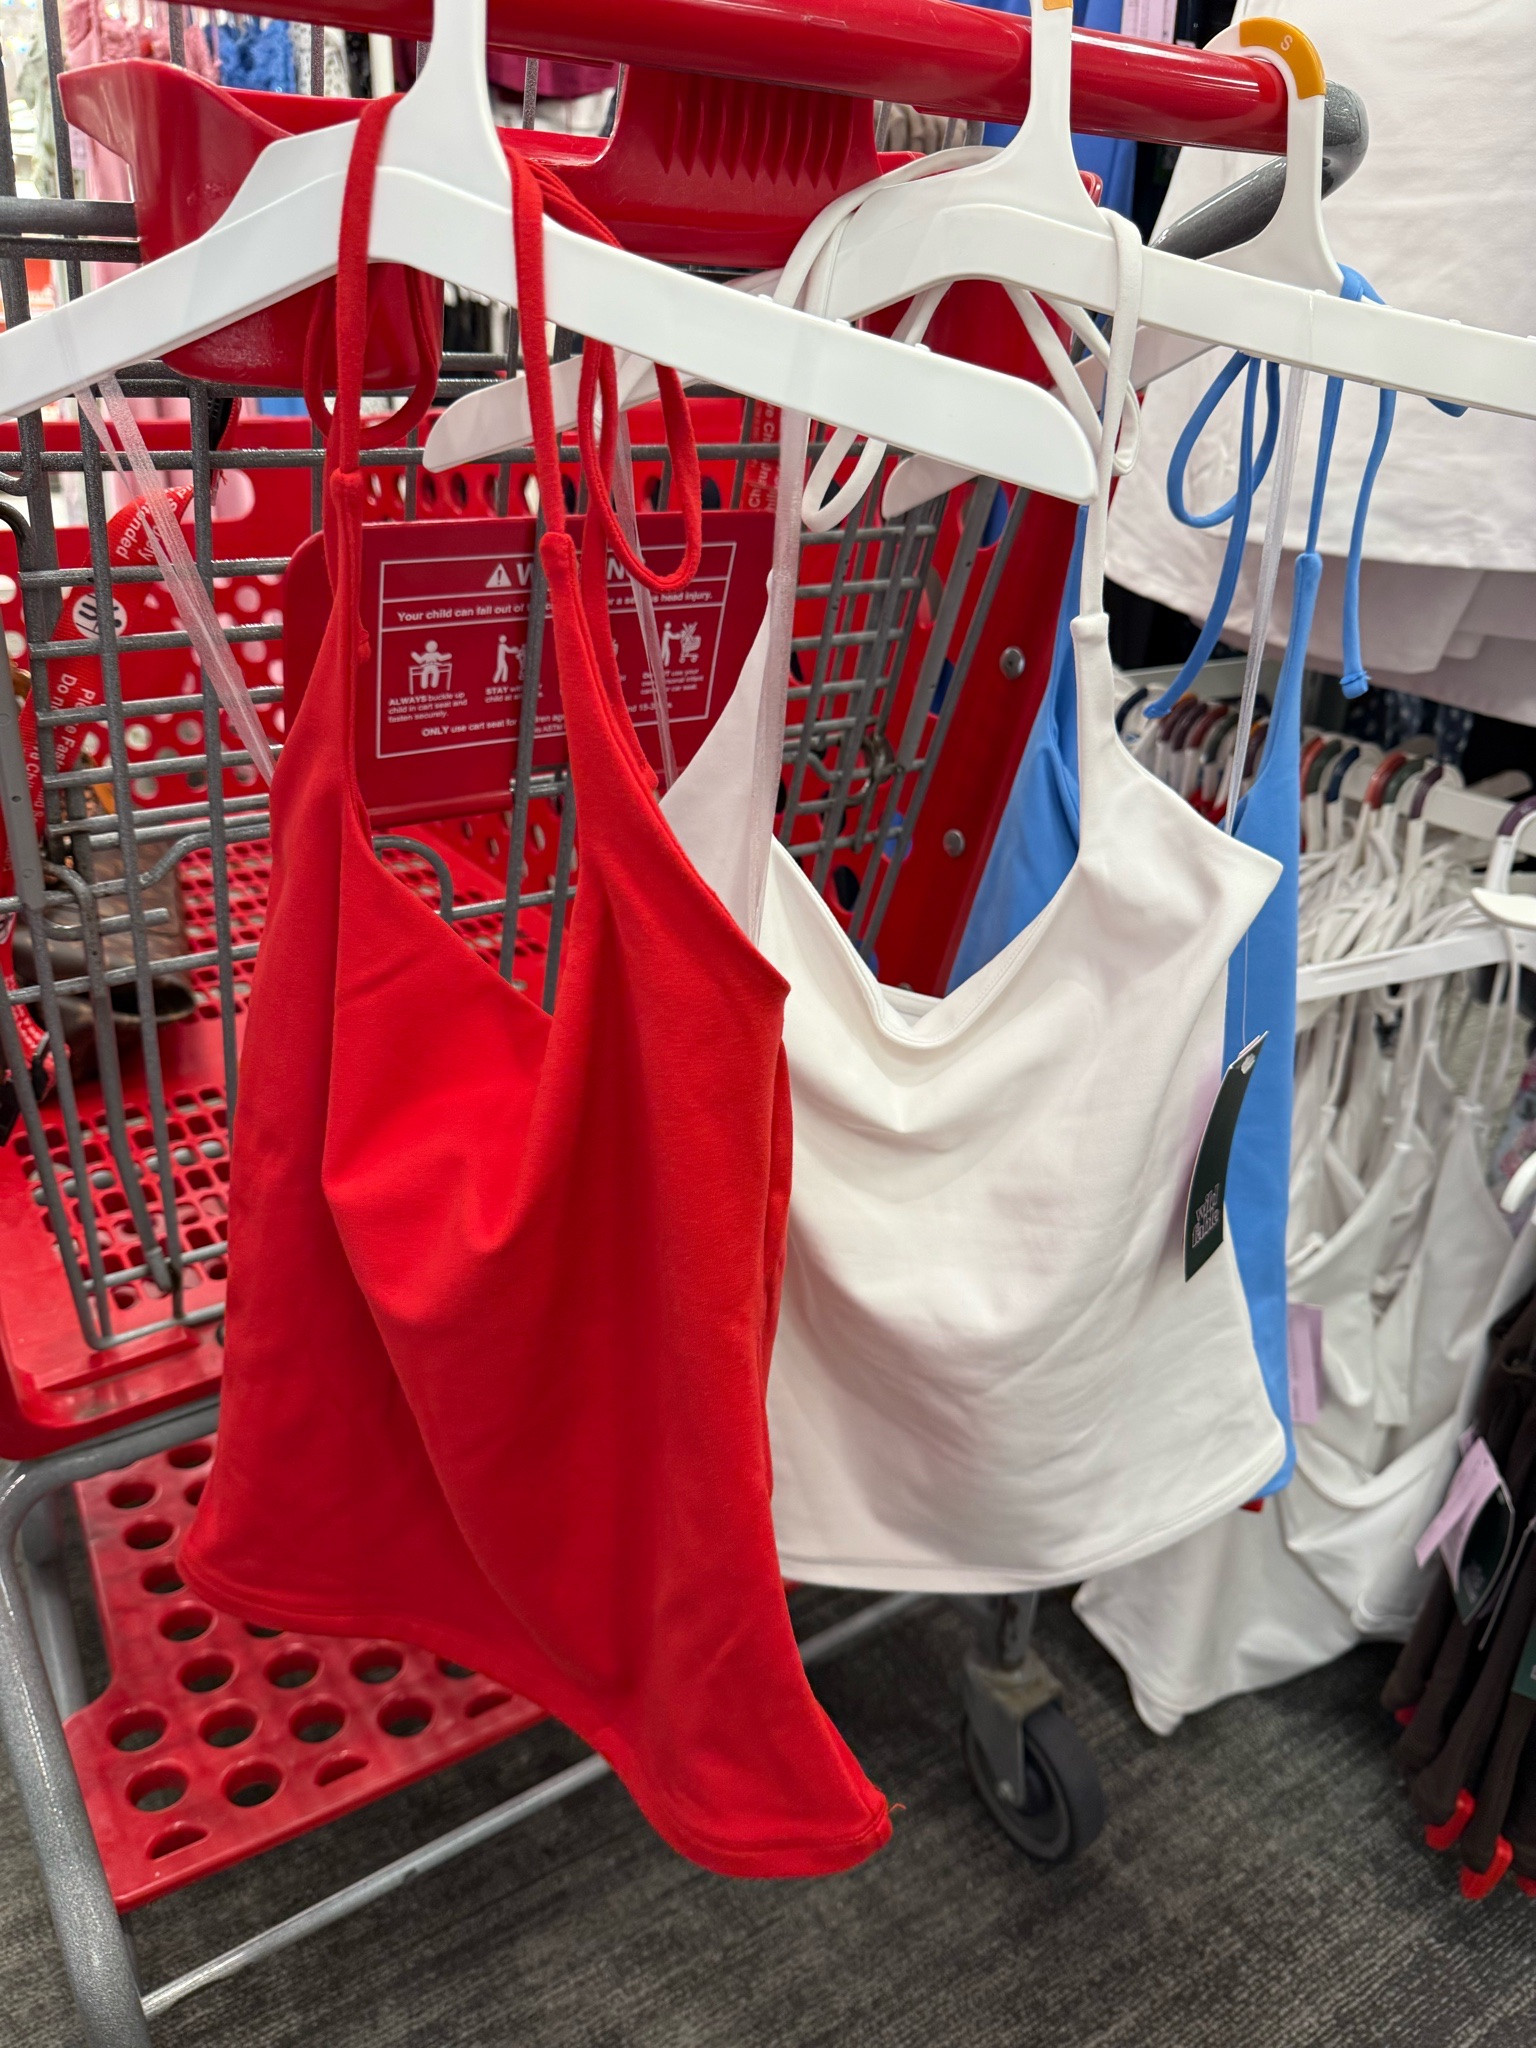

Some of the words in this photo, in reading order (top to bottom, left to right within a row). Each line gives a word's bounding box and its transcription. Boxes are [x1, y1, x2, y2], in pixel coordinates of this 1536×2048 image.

[1280, 34, 1293, 51] S
[397, 611, 423, 622] Your
[426, 609, 452, 620] child
[454, 609, 474, 618] can
[476, 605, 493, 616] fall
[494, 604, 512, 615] out
[57, 673, 78, 695] Do
[485, 686, 509, 696] STAY
[388, 705, 408, 715] child
[409, 704, 417, 713] in
[418, 702, 433, 712] cart
[435, 700, 452, 710] seat
[452, 698, 468, 708] and
[389, 694, 427, 707] ALWAYS
[428, 693, 453, 702] buckle
[455, 691, 466, 701] up
[388, 714, 413, 724] fasten
[421, 725, 449, 737] ONLY
[451, 724, 467, 734] use
[468, 721, 485, 732] cart
[487, 719, 505, 729] seat
